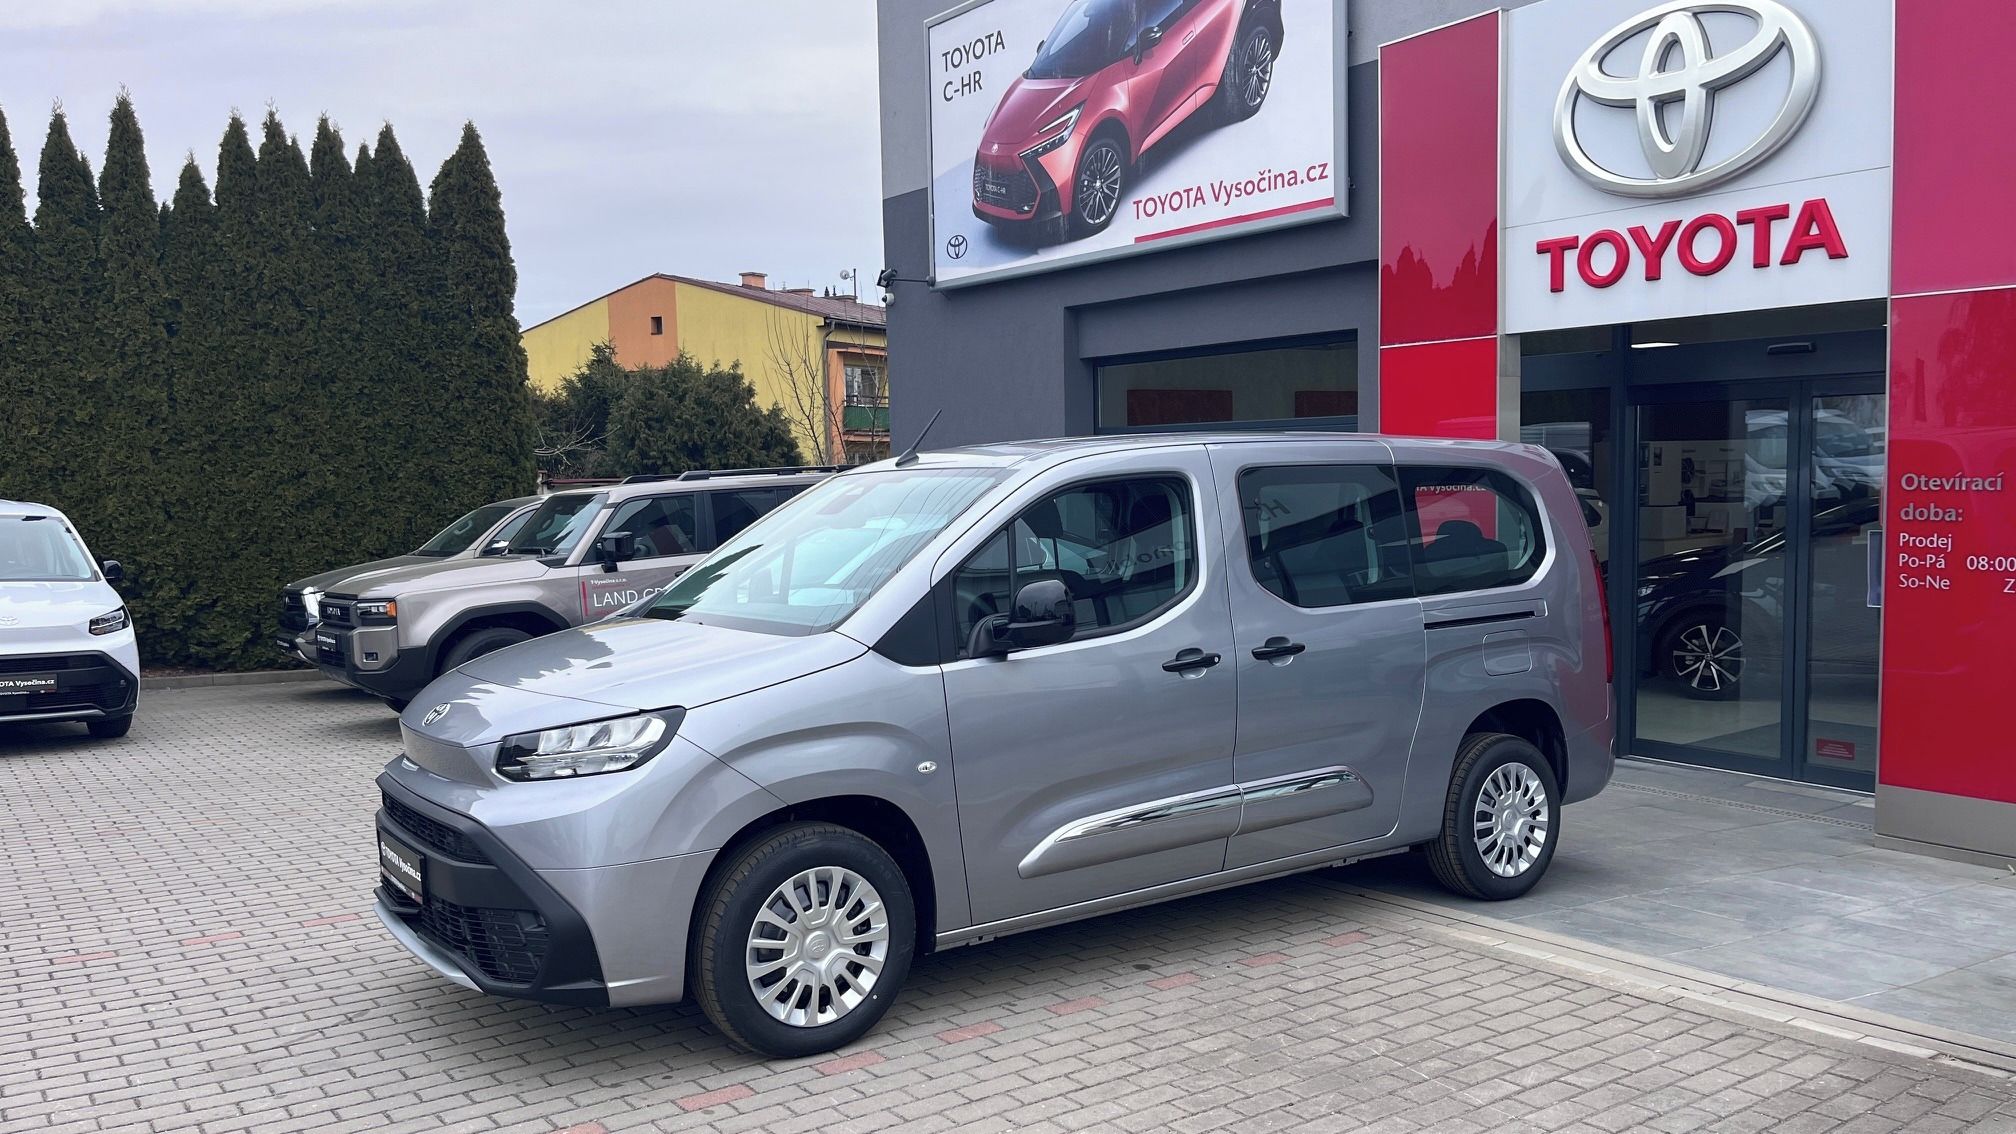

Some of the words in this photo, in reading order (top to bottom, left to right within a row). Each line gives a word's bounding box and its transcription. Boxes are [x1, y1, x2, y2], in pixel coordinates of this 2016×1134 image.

[942, 30, 1005, 72] TOYOTA
[943, 70, 982, 102] C-HR
[1133, 186, 1206, 220] TOYOTA
[1210, 162, 1329, 206] Vysočina.cz
[1536, 198, 1849, 293] TOYOTA
[1900, 471, 2004, 491] Otevírací
[1900, 502, 1963, 521] doba:
[1899, 532, 1952, 552] Prodej
[1899, 553, 1945, 569] Po-Pá
[1966, 555, 2016, 572] 08:00
[1899, 573, 1950, 590] So-Ne
[593, 590, 638, 607] LAND
[15, 679, 55, 688] Vysočina.cz
